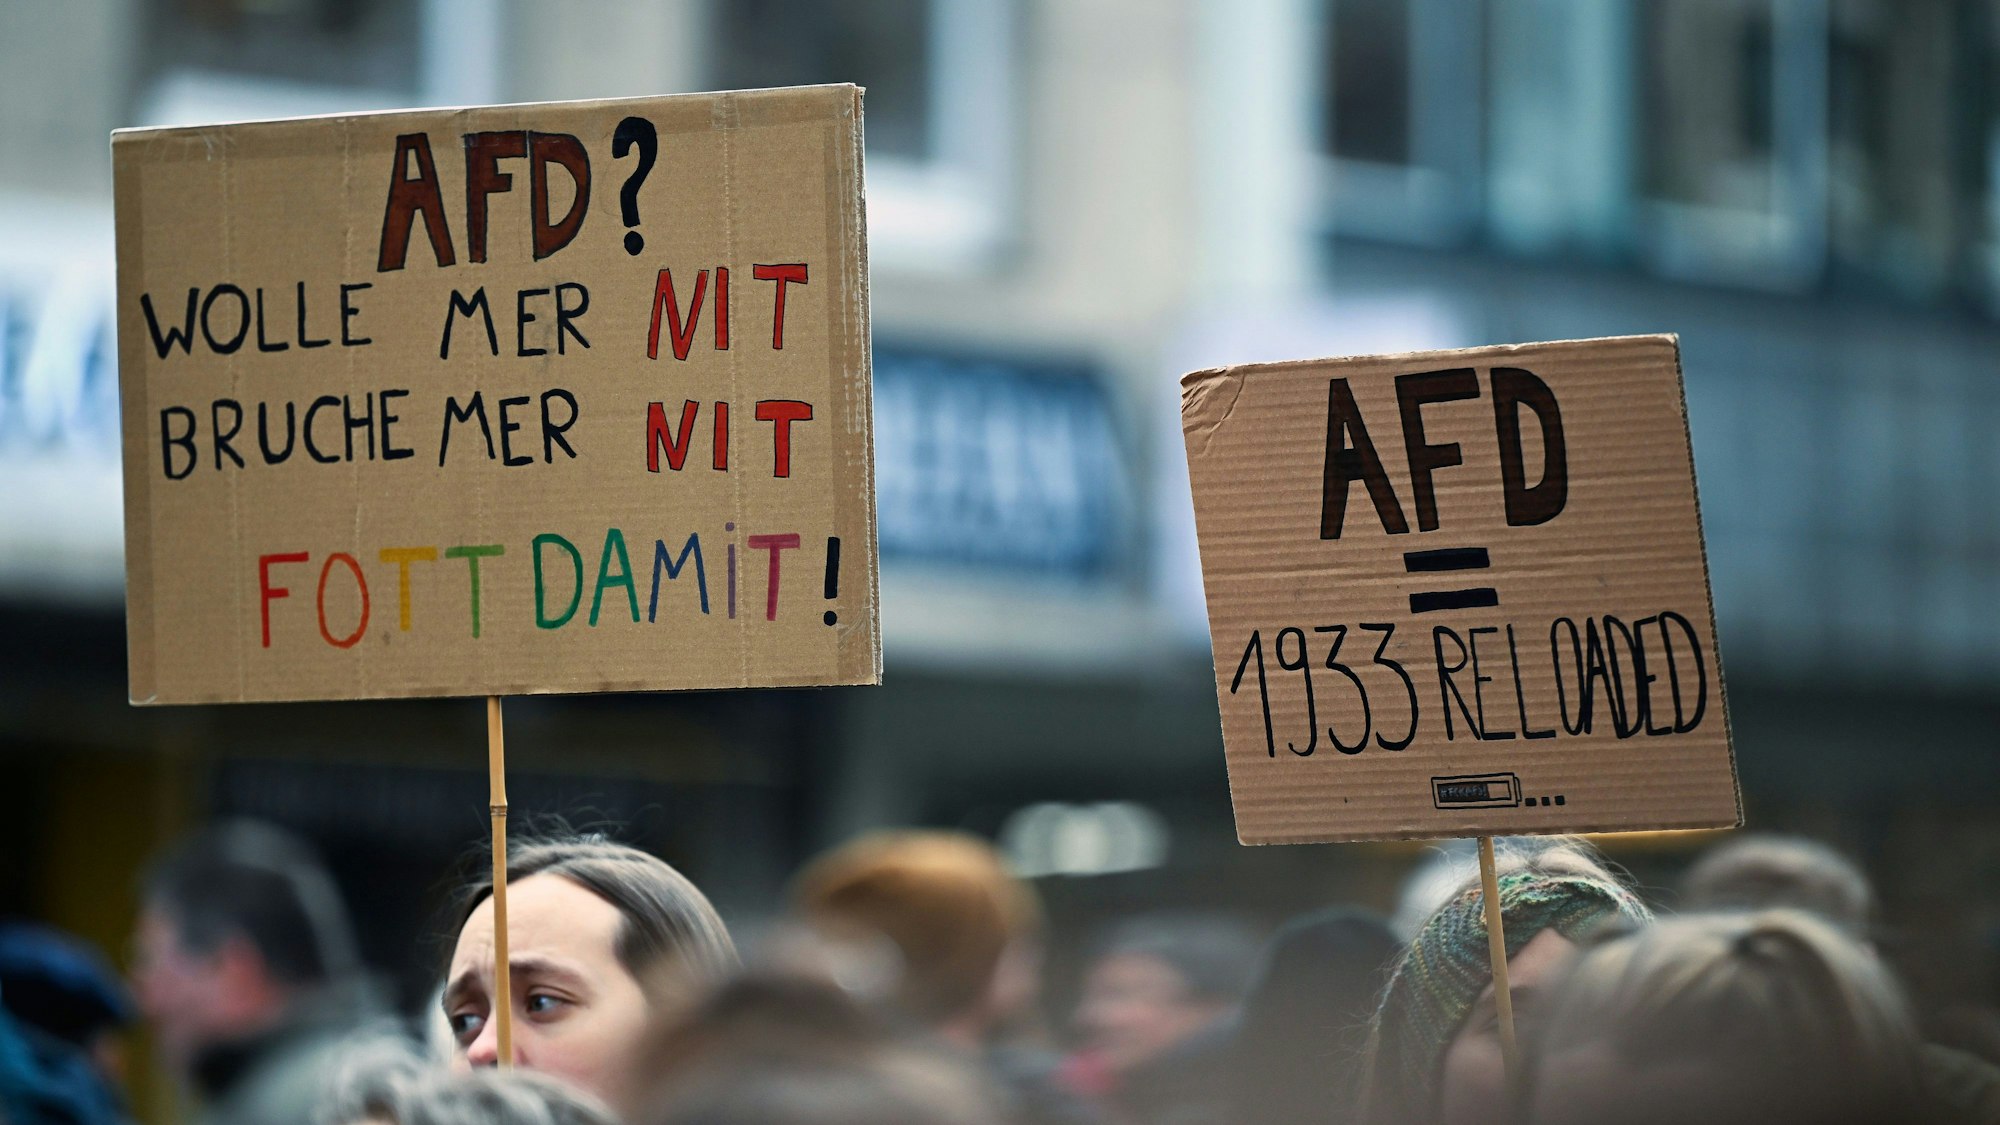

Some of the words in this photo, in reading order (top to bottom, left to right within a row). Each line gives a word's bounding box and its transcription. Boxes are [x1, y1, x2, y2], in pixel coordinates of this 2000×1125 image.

[377, 116, 659, 272] AFD?
[140, 281, 374, 359] WOLLE
[440, 281, 590, 360] MER
[647, 263, 809, 361] NIT
[160, 389, 415, 480] BRUCHE
[438, 388, 579, 467] MER
[646, 400, 813, 478] NIT
[1319, 367, 1568, 540] AFD
[258, 544, 505, 649] FOTT
[1230, 622, 1419, 758] 1933
[1432, 611, 1707, 741] RELOADED
